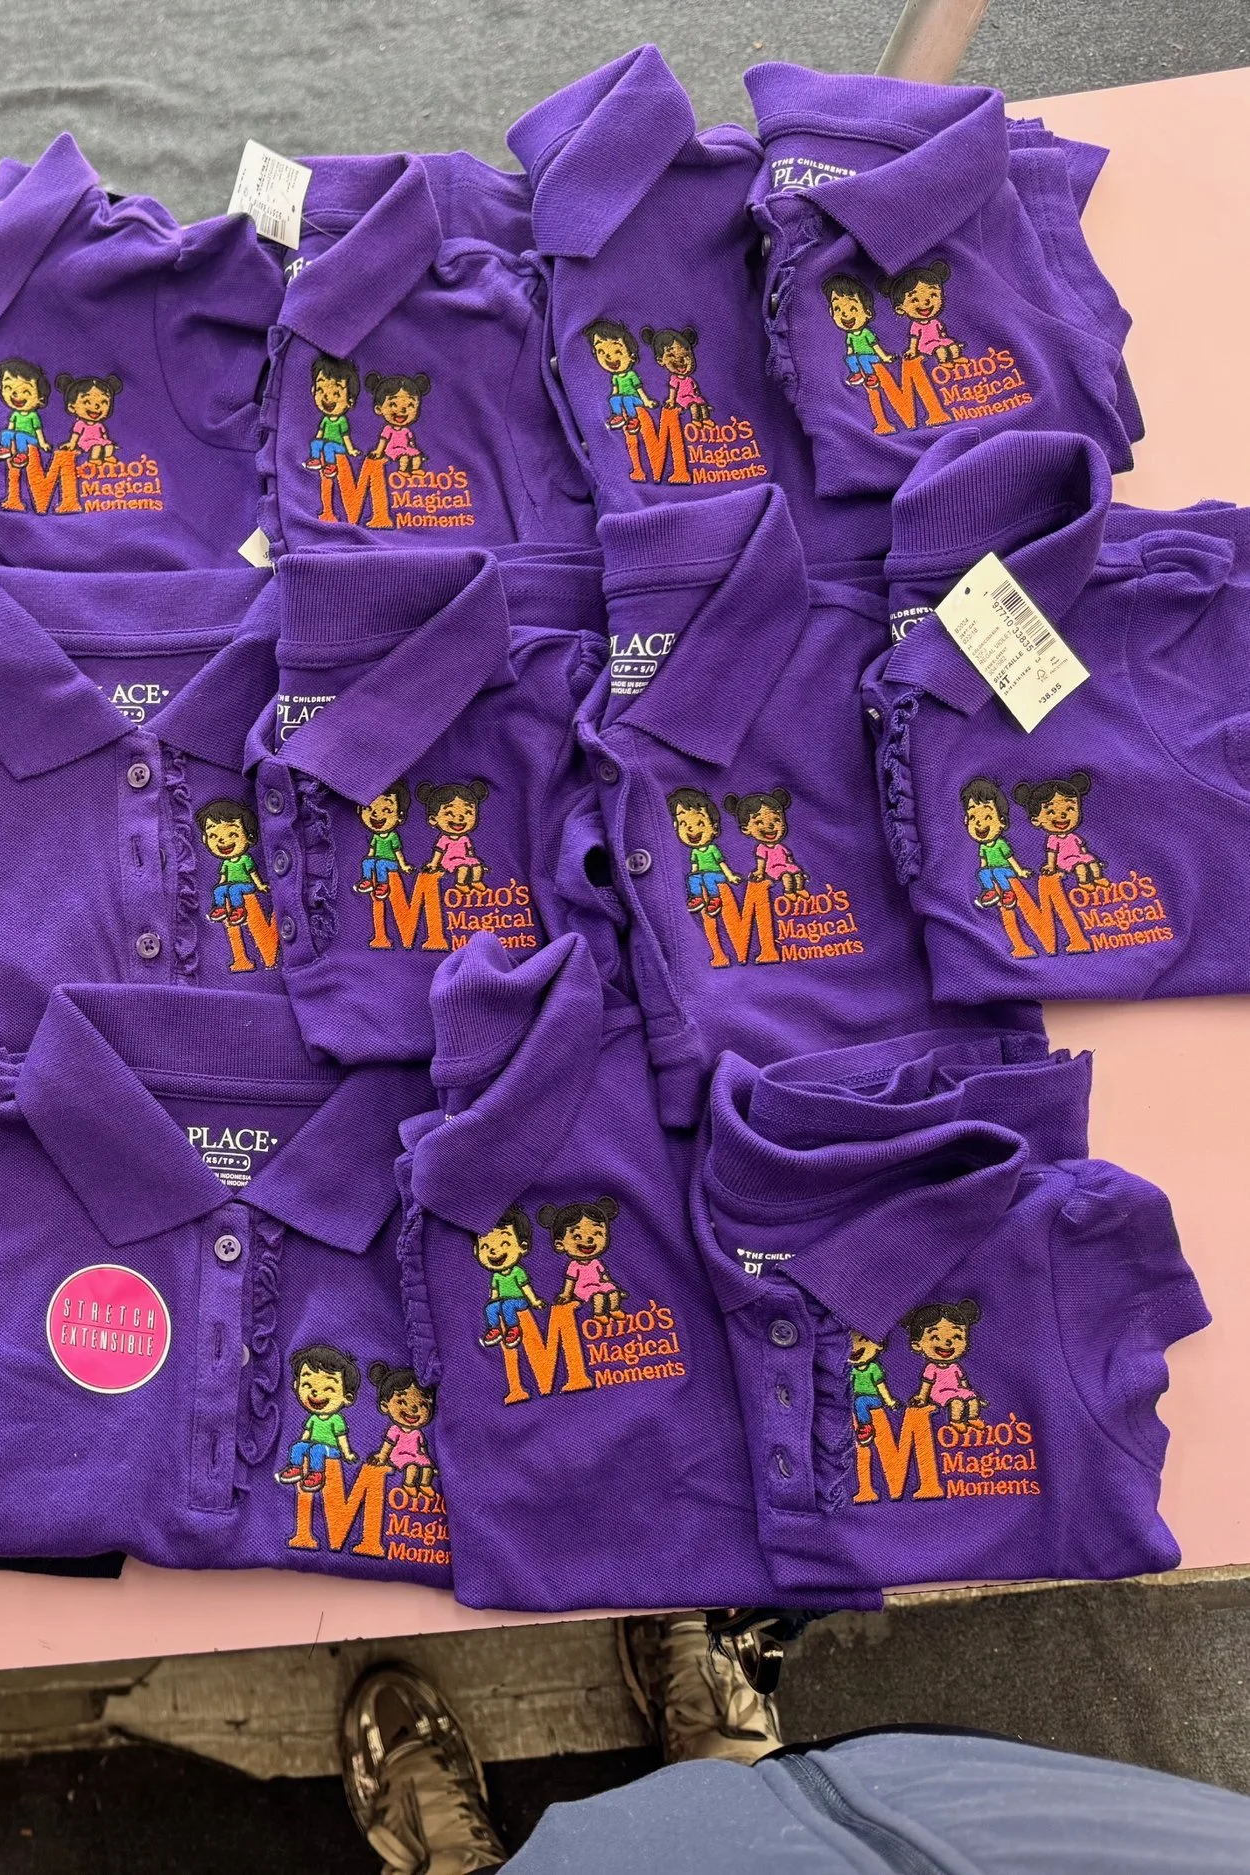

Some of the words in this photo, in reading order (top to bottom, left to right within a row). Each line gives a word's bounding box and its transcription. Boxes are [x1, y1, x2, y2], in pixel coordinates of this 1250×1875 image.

[774, 167, 840, 188] PLAC
[778, 158, 794, 167] THE
[797, 158, 848, 175] CHILDREN'S
[864, 348, 1015, 434] Momo's
[940, 368, 1025, 405] Magical
[951, 392, 1033, 421] Moments
[623, 407, 753, 483] Momo's
[688, 441, 761, 467] Magical
[1, 444, 159, 514] Momo's
[81, 477, 161, 498] Magical
[692, 463, 767, 484] Moments
[318, 453, 468, 529] Momo's
[391, 490, 472, 512] Magical
[85, 498, 164, 514] Moments
[396, 511, 475, 529] Moments
[890, 607, 929, 620] LDREN'S
[992, 601, 1014, 628] 97710
[1012, 626, 1034, 652] 33835
[994, 650, 1024, 684] SIZE/TAILLE
[108, 684, 161, 704] ACE
[999, 674, 1011, 690] 4T
[1038, 682, 1062, 704] $38.95
[370, 871, 529, 950] Momo's
[446, 908, 535, 934] Magical
[702, 881, 850, 968] Momo's
[1000, 871, 1156, 958] Momo's
[1078, 899, 1166, 931] Magical
[452, 932, 537, 952] Ments
[777, 913, 858, 943] Magical
[1090, 925, 1173, 952] Moments
[781, 939, 864, 962] Moments
[187, 1126, 269, 1152] PLACE
[746, 1251, 764, 1260] THE
[63, 1298, 156, 1330] STRETCH
[61, 1324, 153, 1357] EXTENSIBLE
[500, 1300, 674, 1405] Momo's
[586, 1332, 680, 1366] Magical
[595, 1360, 685, 1389] Moments
[853, 1405, 1032, 1504] Momo's
[941, 1449, 1037, 1478] Magical
[947, 1478, 1041, 1499] Moments
[289, 1458, 447, 1557] Mom
[385, 1513, 450, 1546] Magi
[387, 1541, 450, 1564] Mome
